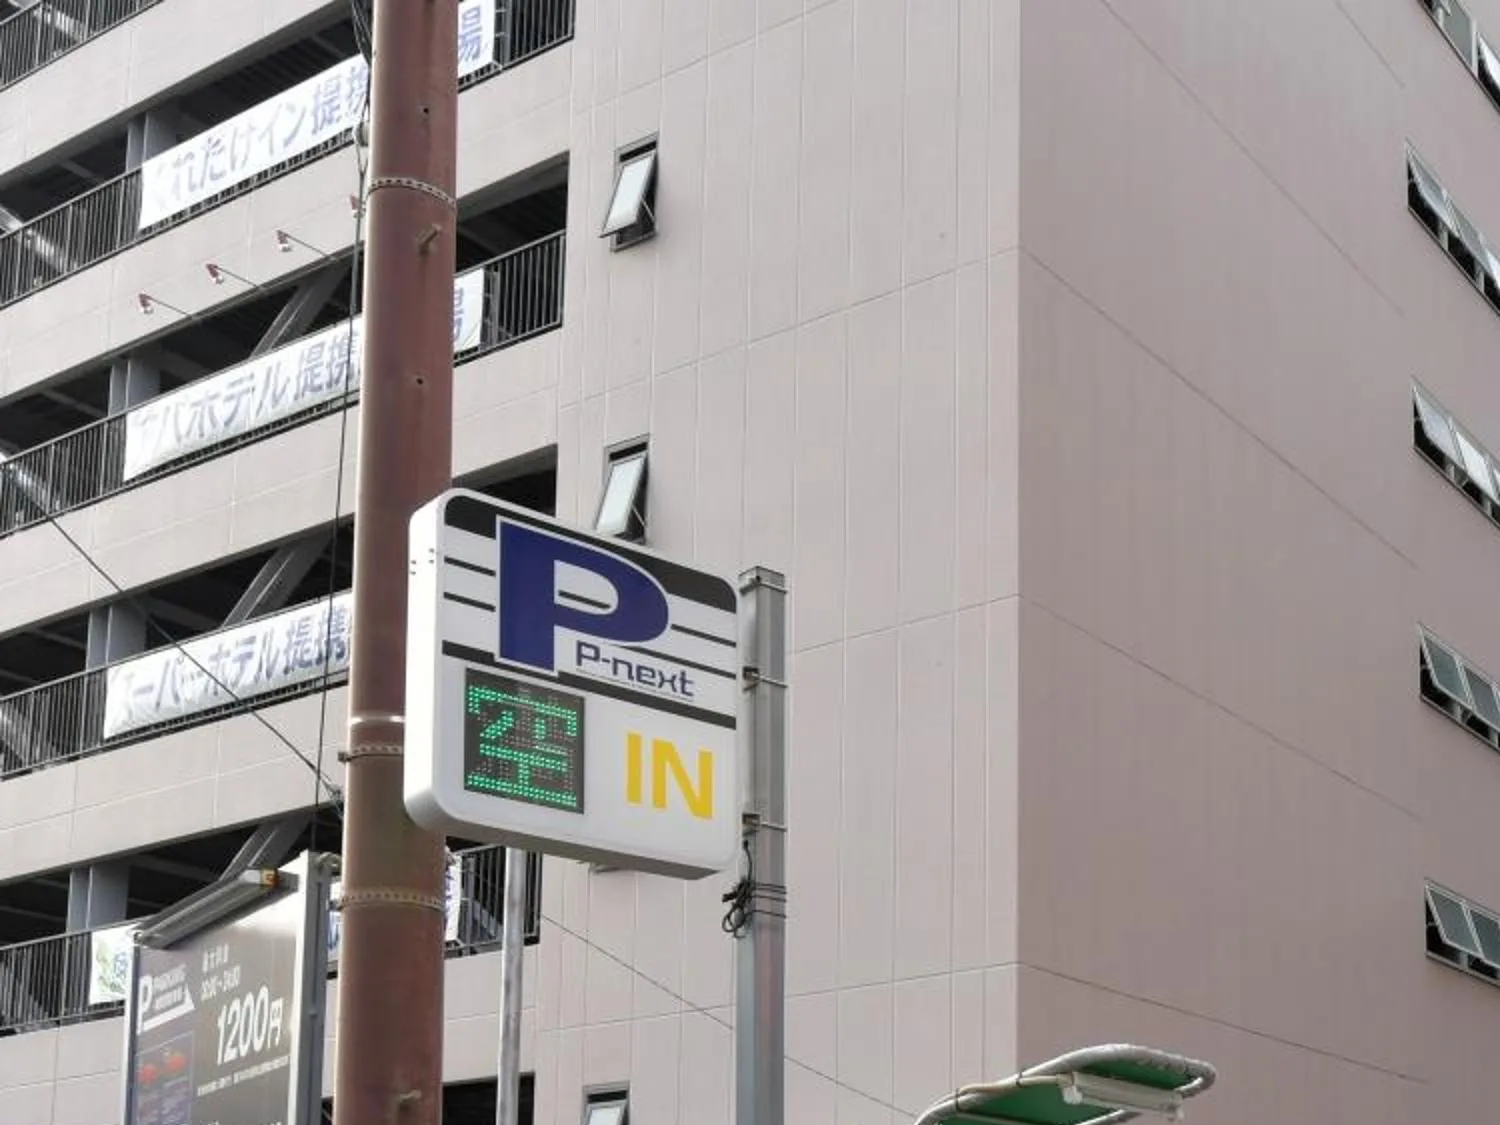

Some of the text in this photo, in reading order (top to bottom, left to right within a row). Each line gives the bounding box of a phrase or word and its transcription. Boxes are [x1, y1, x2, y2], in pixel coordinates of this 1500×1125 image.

[575, 640, 697, 698] P-next
[626, 731, 714, 821] IN
[216, 983, 285, 1066] 1200円
